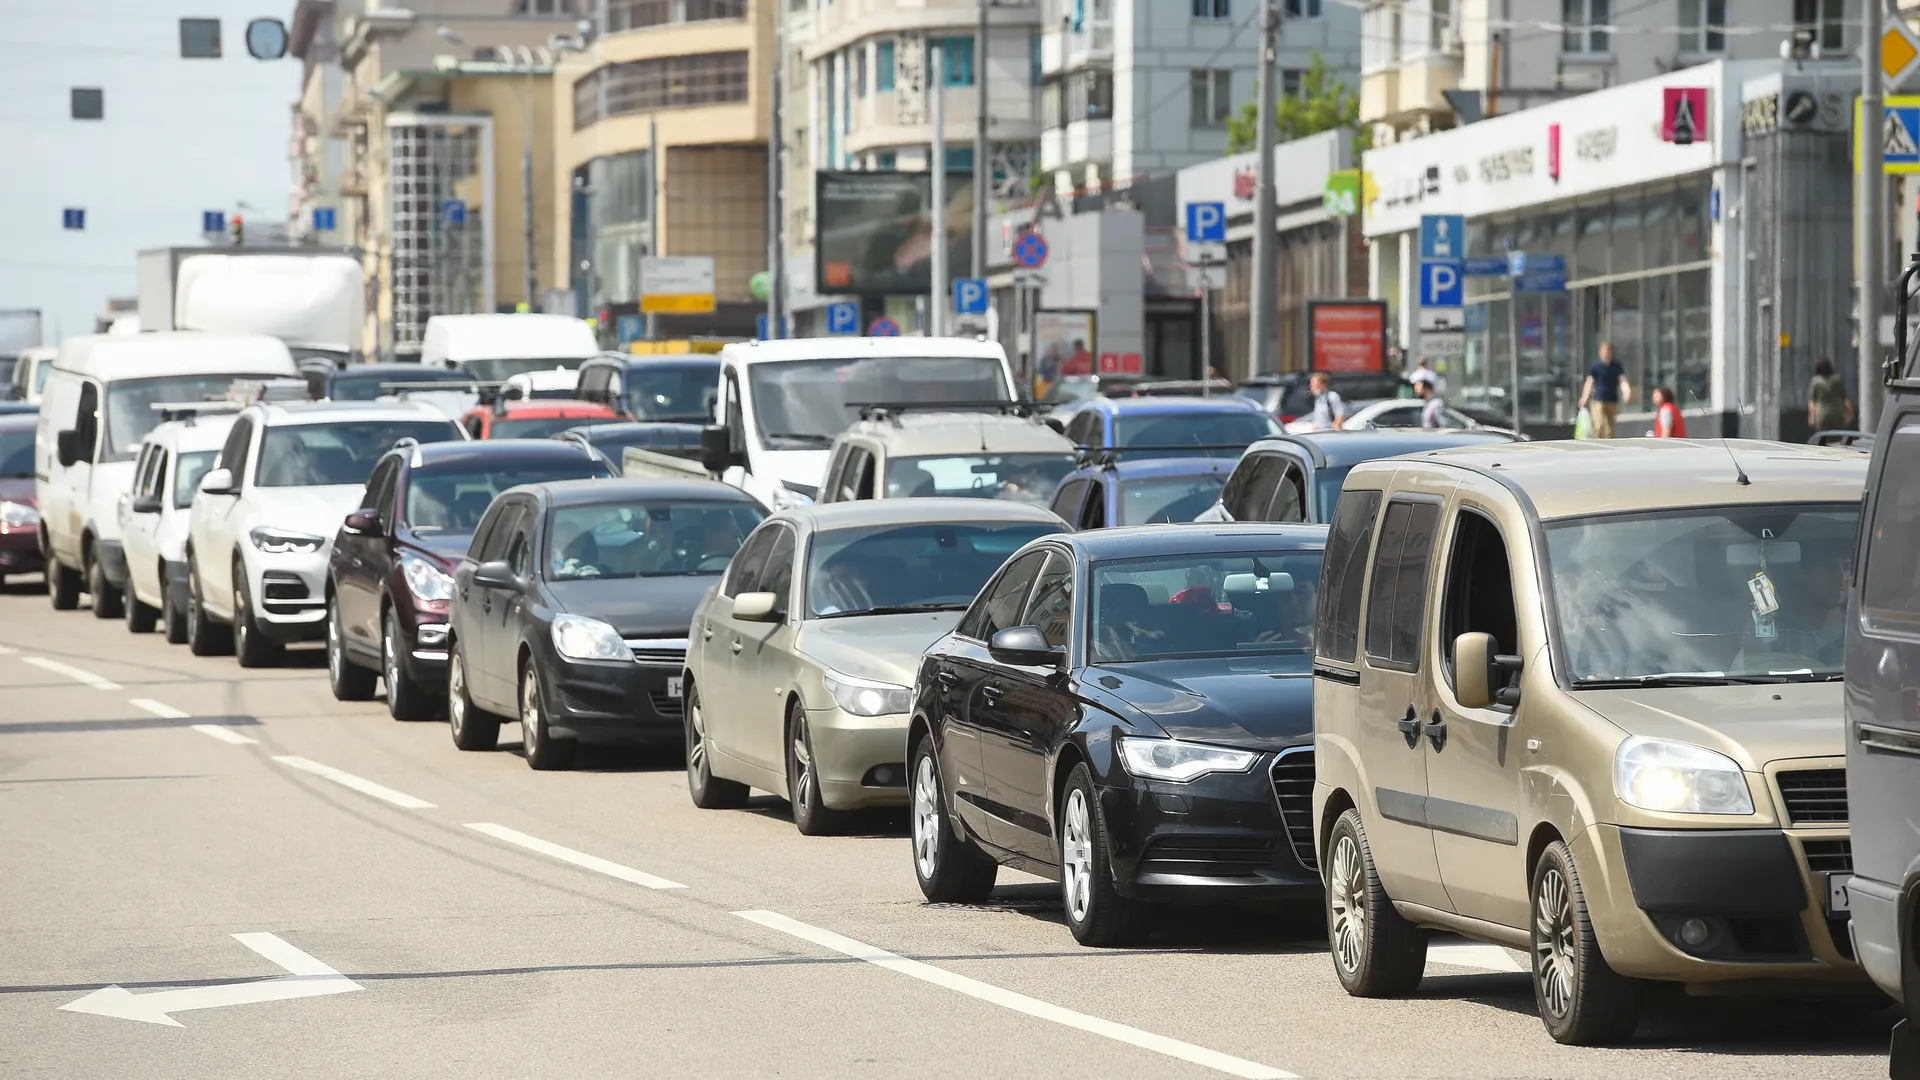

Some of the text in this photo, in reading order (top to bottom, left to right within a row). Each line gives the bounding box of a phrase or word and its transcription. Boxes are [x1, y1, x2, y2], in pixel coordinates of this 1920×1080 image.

[1326, 190, 1355, 215] 24
[1196, 205, 1220, 239] P
[961, 282, 982, 312] P
[1430, 266, 1456, 304] P
[833, 305, 854, 332] P
